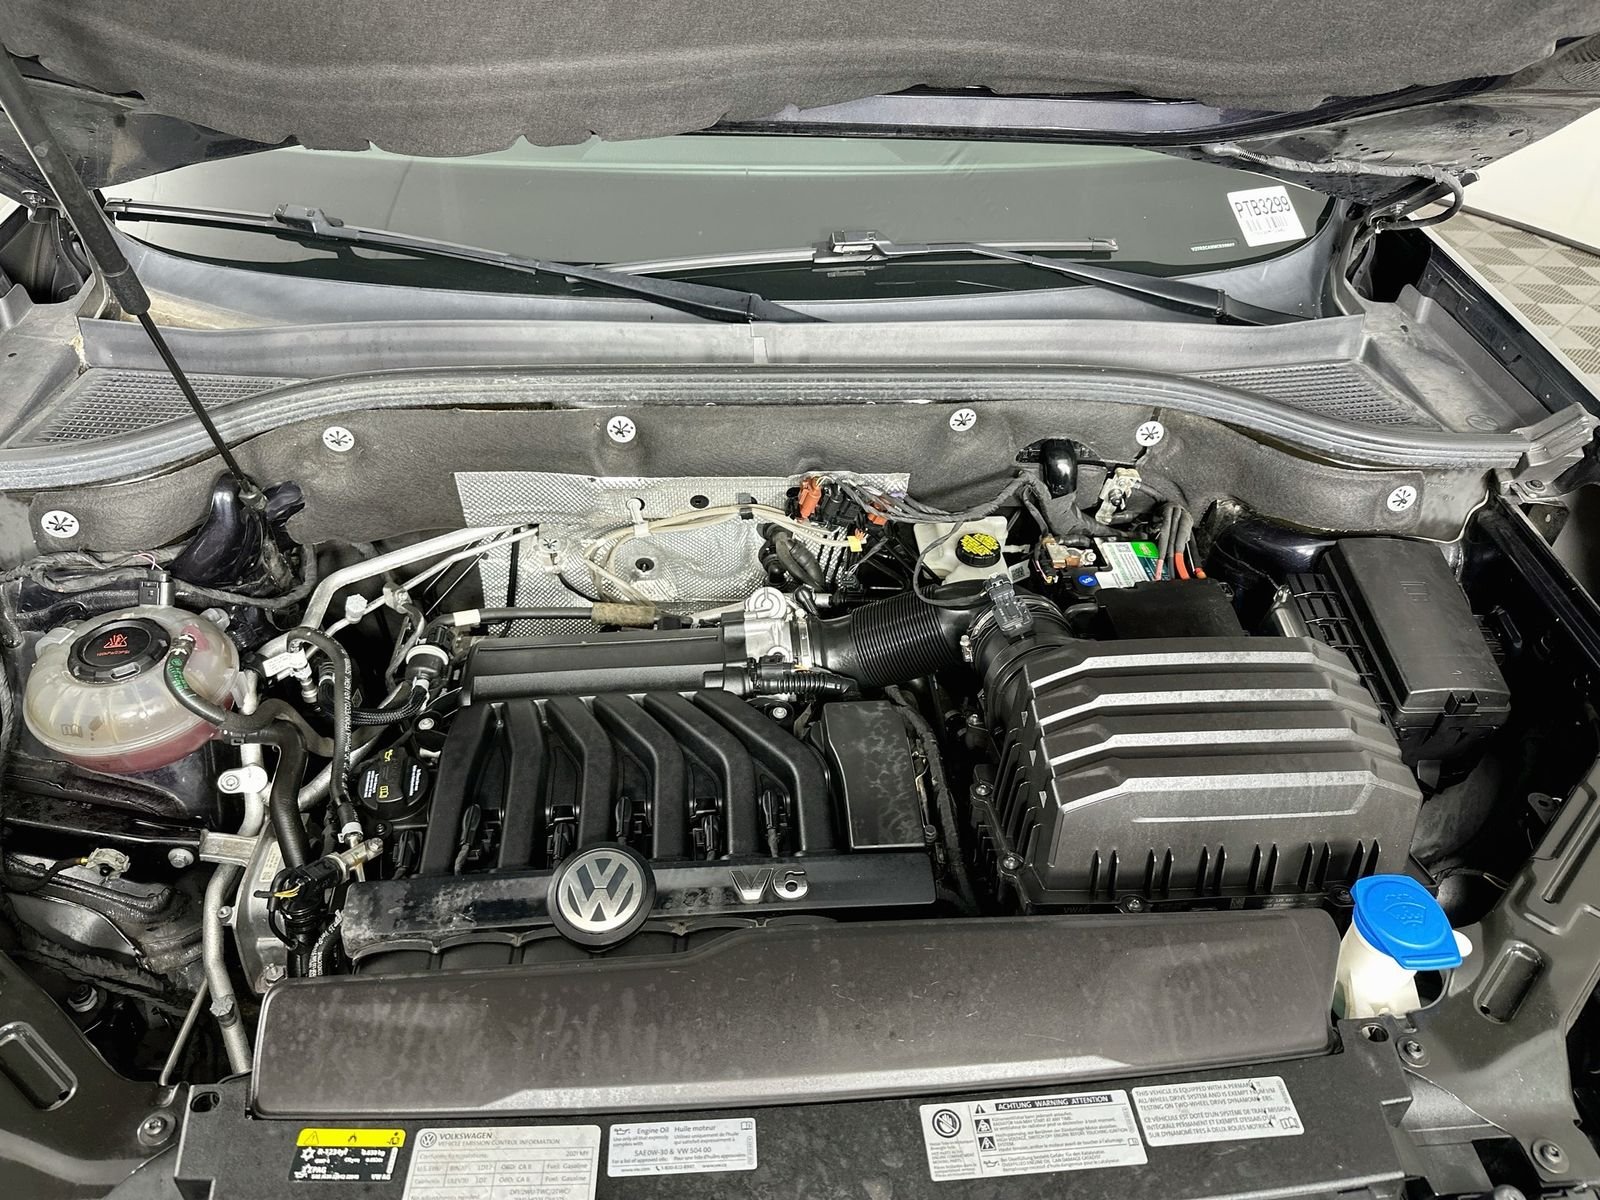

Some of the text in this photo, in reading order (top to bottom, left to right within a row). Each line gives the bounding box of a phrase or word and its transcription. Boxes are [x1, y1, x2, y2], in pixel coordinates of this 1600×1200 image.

[1235, 196, 1291, 218] PTB3299
[729, 867, 808, 903] V6
[1169, 1094, 1187, 1102] DRIVE
[1188, 1092, 1208, 1100] SYSTEM
[1228, 1089, 1249, 1097] EXEMPT
[998, 1096, 1108, 1110] ACHTUNG WARNING ATTENTION
[1140, 1103, 1165, 1111] TESTING
[1174, 1100, 1210, 1108] TWO-WHEEL
[1251, 1106, 1291, 1114] TRANMISSION
[1176, 1119, 1208, 1128] PERMANENT
[1228, 1124, 1246, 1132] ROUES
[440, 1132, 493, 1140] VOLKSWAGEN
[637, 1128, 659, 1136] Engine
[634, 1149, 647, 1157] SAE
[647, 1148, 669, 1157] 0W-30
[676, 1147, 689, 1155] VW
